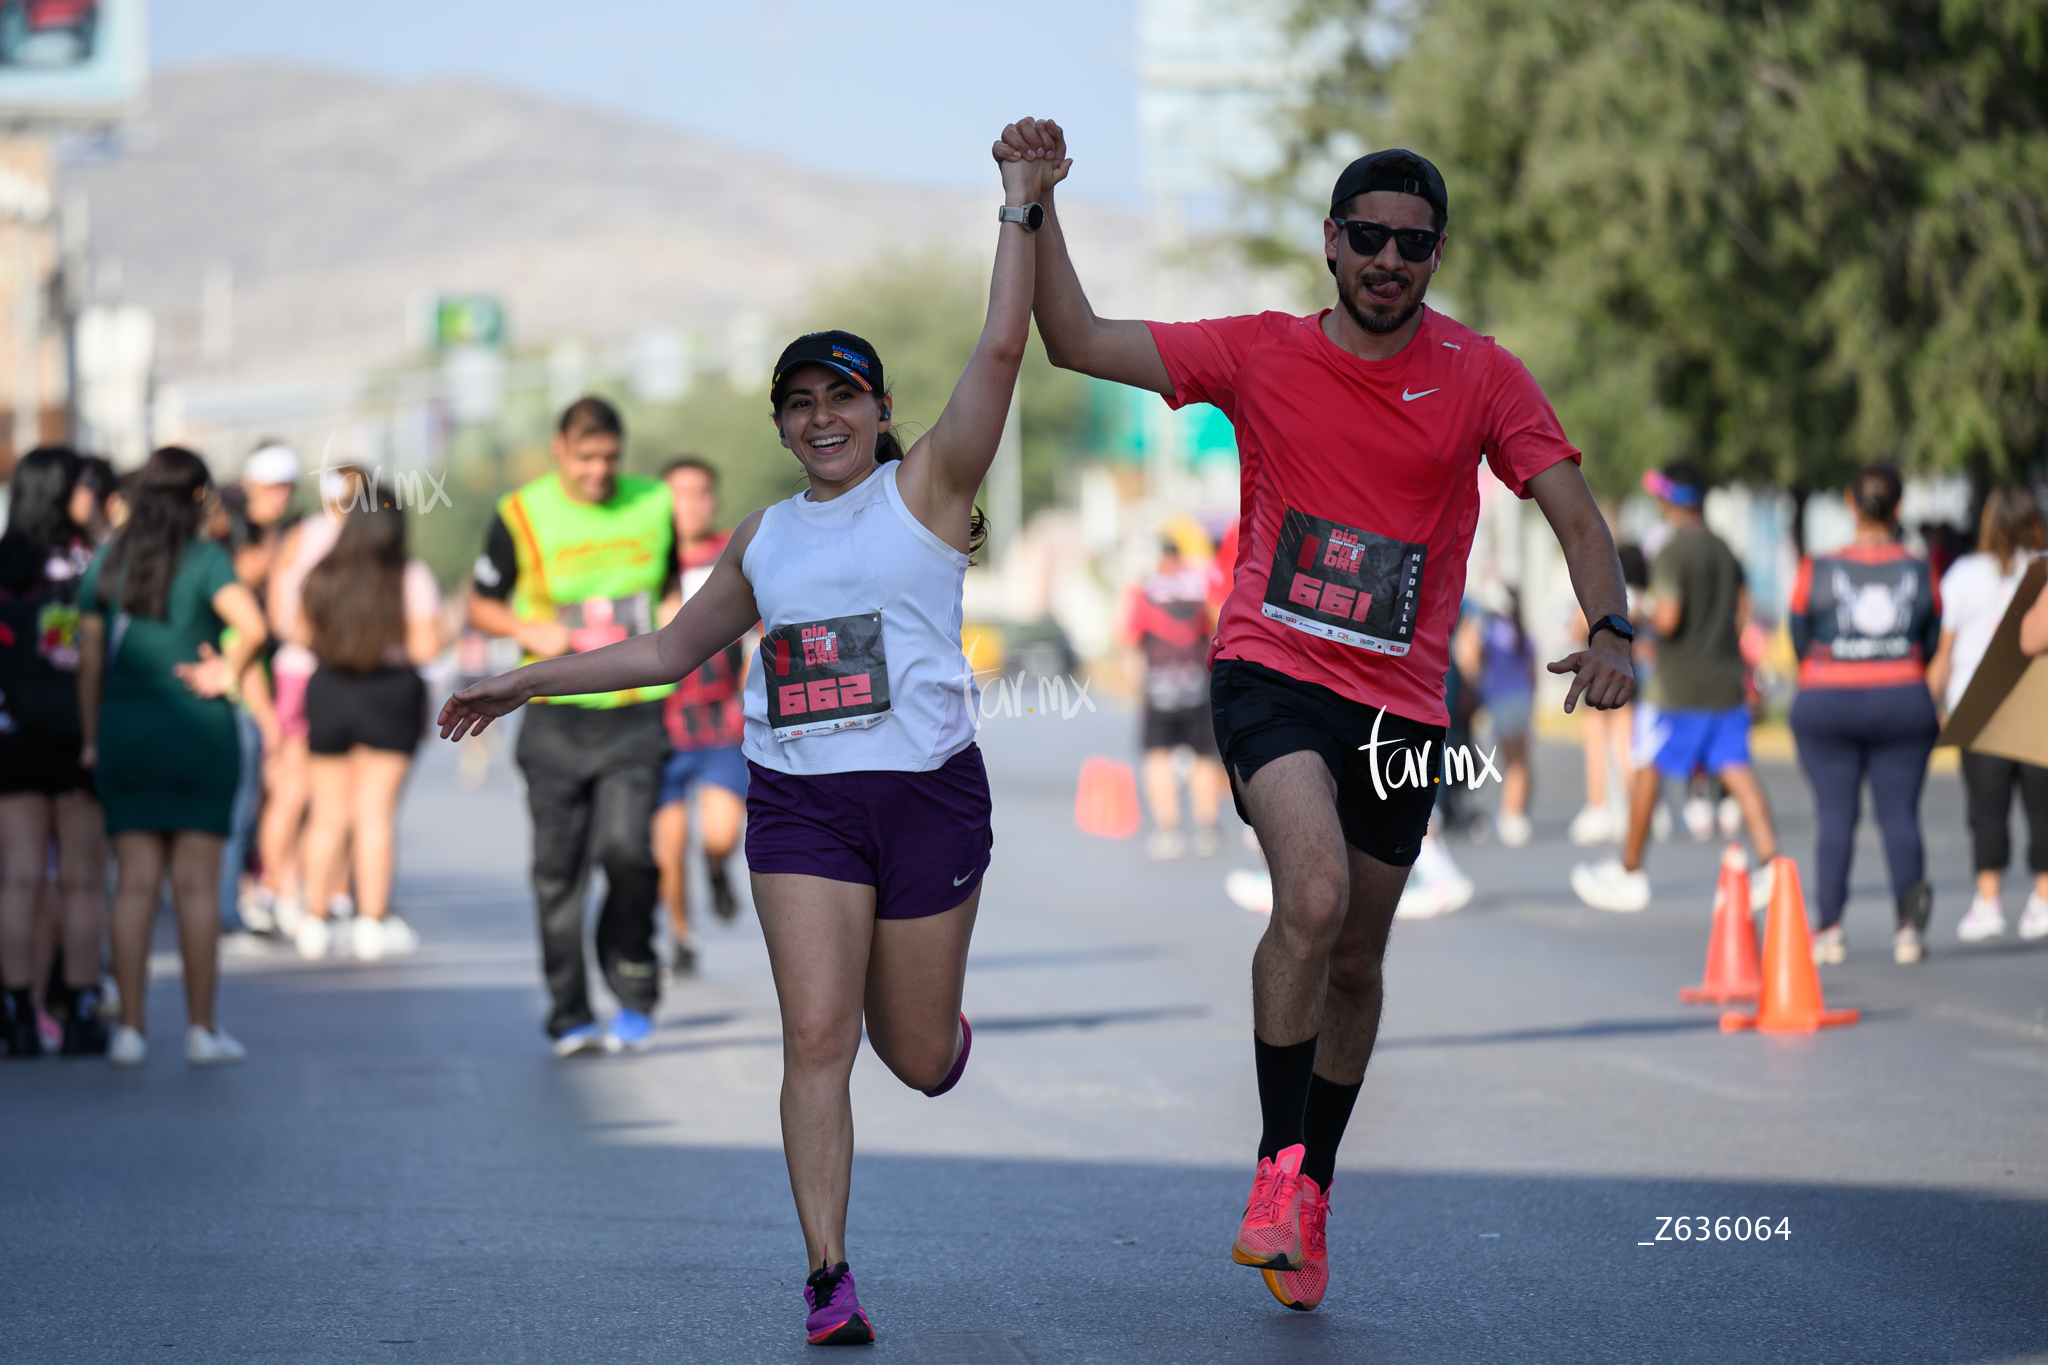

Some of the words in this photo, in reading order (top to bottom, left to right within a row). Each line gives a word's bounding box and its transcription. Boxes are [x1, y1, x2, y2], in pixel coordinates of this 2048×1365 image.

[1288, 572, 1373, 623] 661
[1399, 553, 1420, 634] MEDALLA
[1390, 645, 1405, 654] 661
[778, 673, 872, 716] 662
